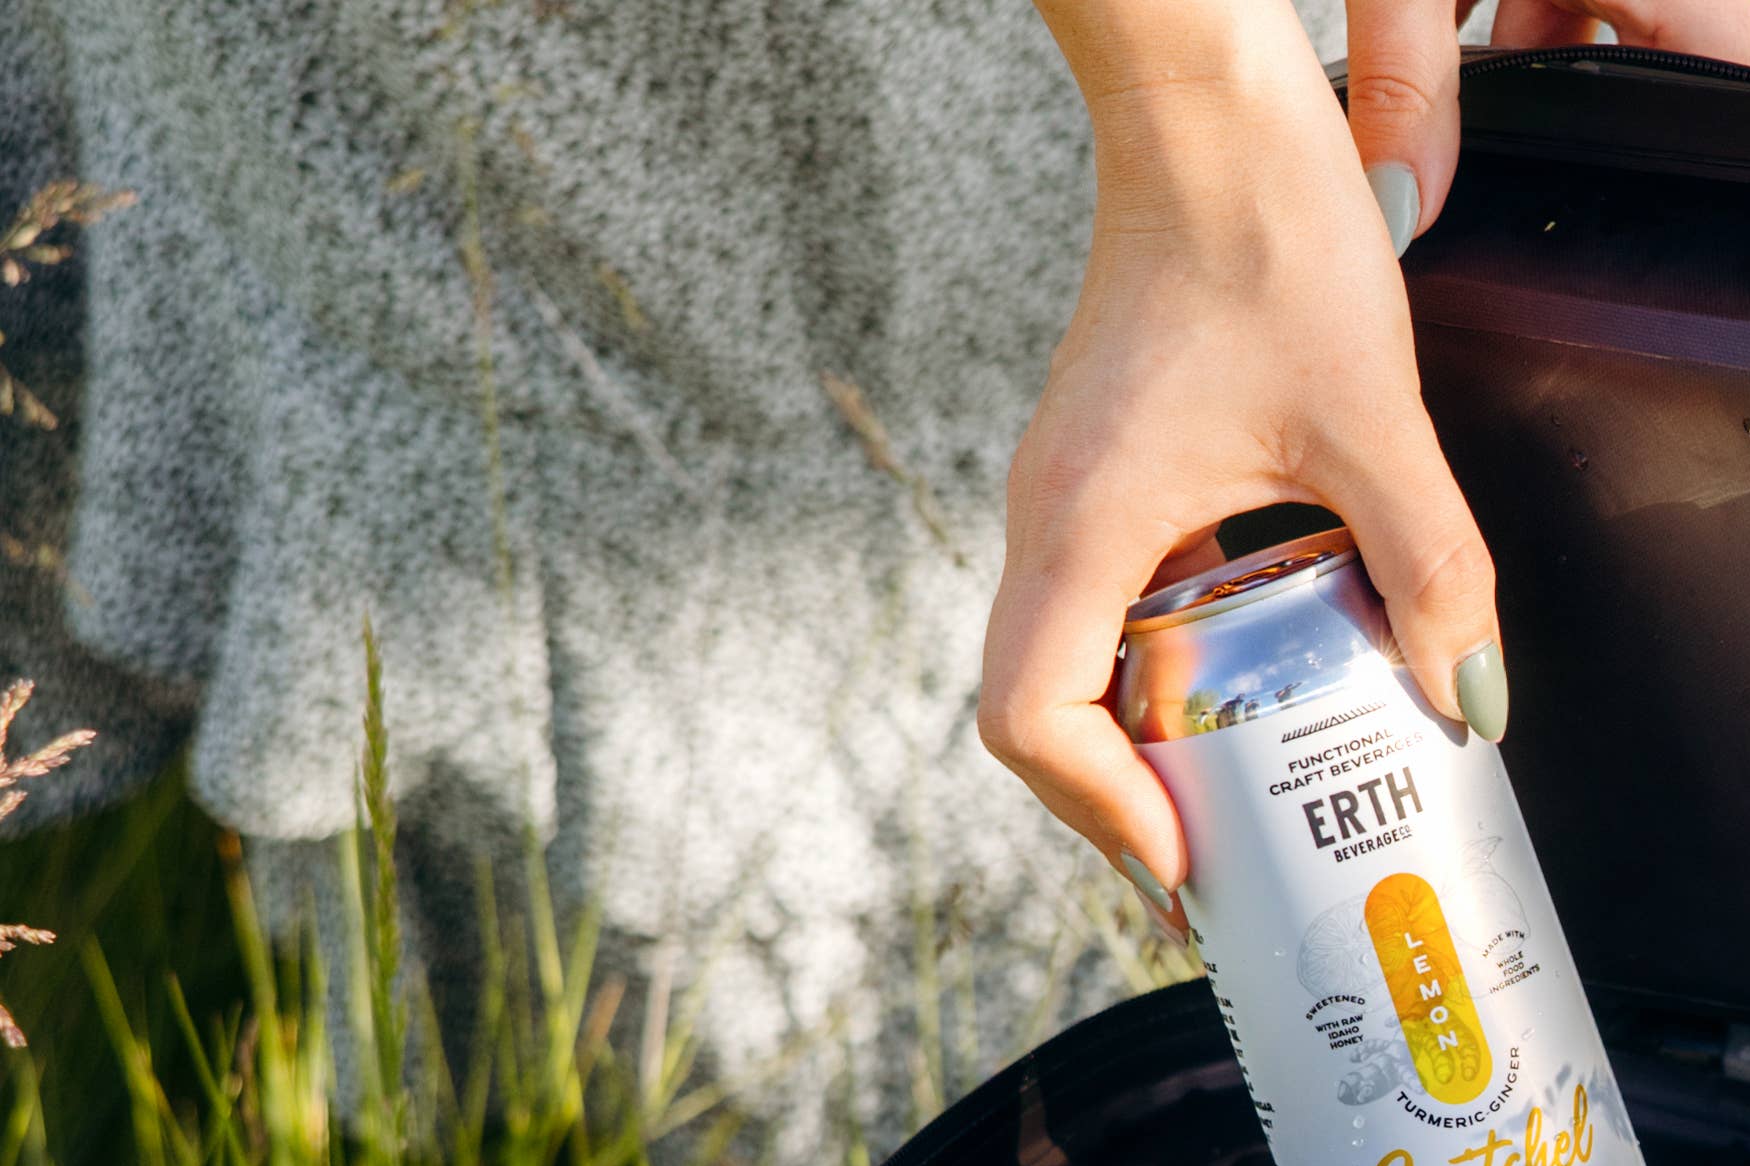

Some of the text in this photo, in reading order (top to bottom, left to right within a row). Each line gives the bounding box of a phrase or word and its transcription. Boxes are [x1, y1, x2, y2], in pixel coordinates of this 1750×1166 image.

[1269, 732, 1424, 796] CRAFT BEVERAGES
[1288, 729, 1393, 773] FUNCTIONAL
[1302, 766, 1423, 849] ERTH
[1334, 828, 1400, 863] BEVERAGE
[1482, 930, 1525, 958] MADE WITH
[1496, 950, 1524, 969] WHOLE
[1503, 961, 1525, 977] FOOD
[1404, 932, 1459, 1051] LEMON
[1489, 963, 1540, 995] INGREDIENTS
[1306, 995, 1366, 1021] SWEETENED
[1315, 1014, 1363, 1032] WITH RAW
[1328, 1026, 1359, 1040] IDAHO
[1330, 1034, 1364, 1050] HONEY
